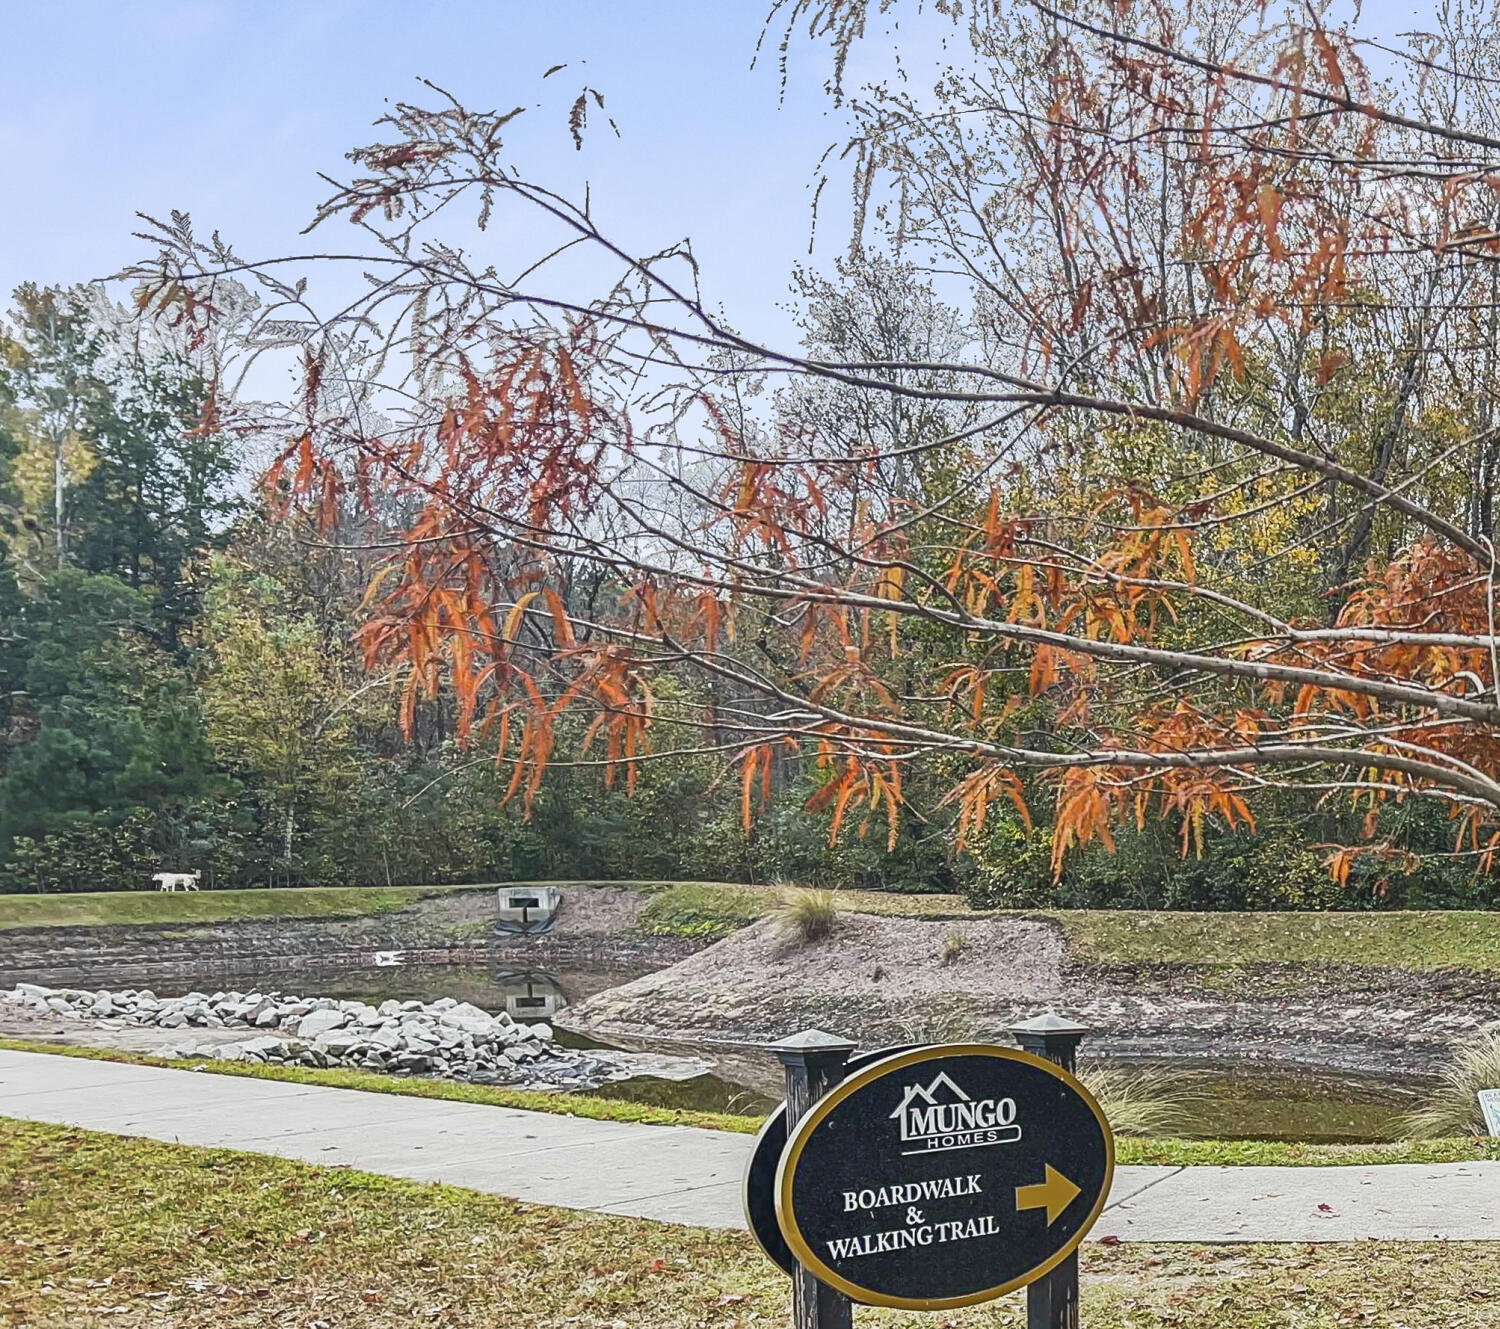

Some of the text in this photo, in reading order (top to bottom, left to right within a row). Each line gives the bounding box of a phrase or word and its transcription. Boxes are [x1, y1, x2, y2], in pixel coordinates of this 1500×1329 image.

[909, 1098, 1016, 1136] MUNGO
[927, 1131, 998, 1149] HOMES
[842, 1174, 983, 1212] BOARDWALK
[906, 1206, 926, 1225] &
[826, 1216, 1000, 1260] WALKING TRAIL
